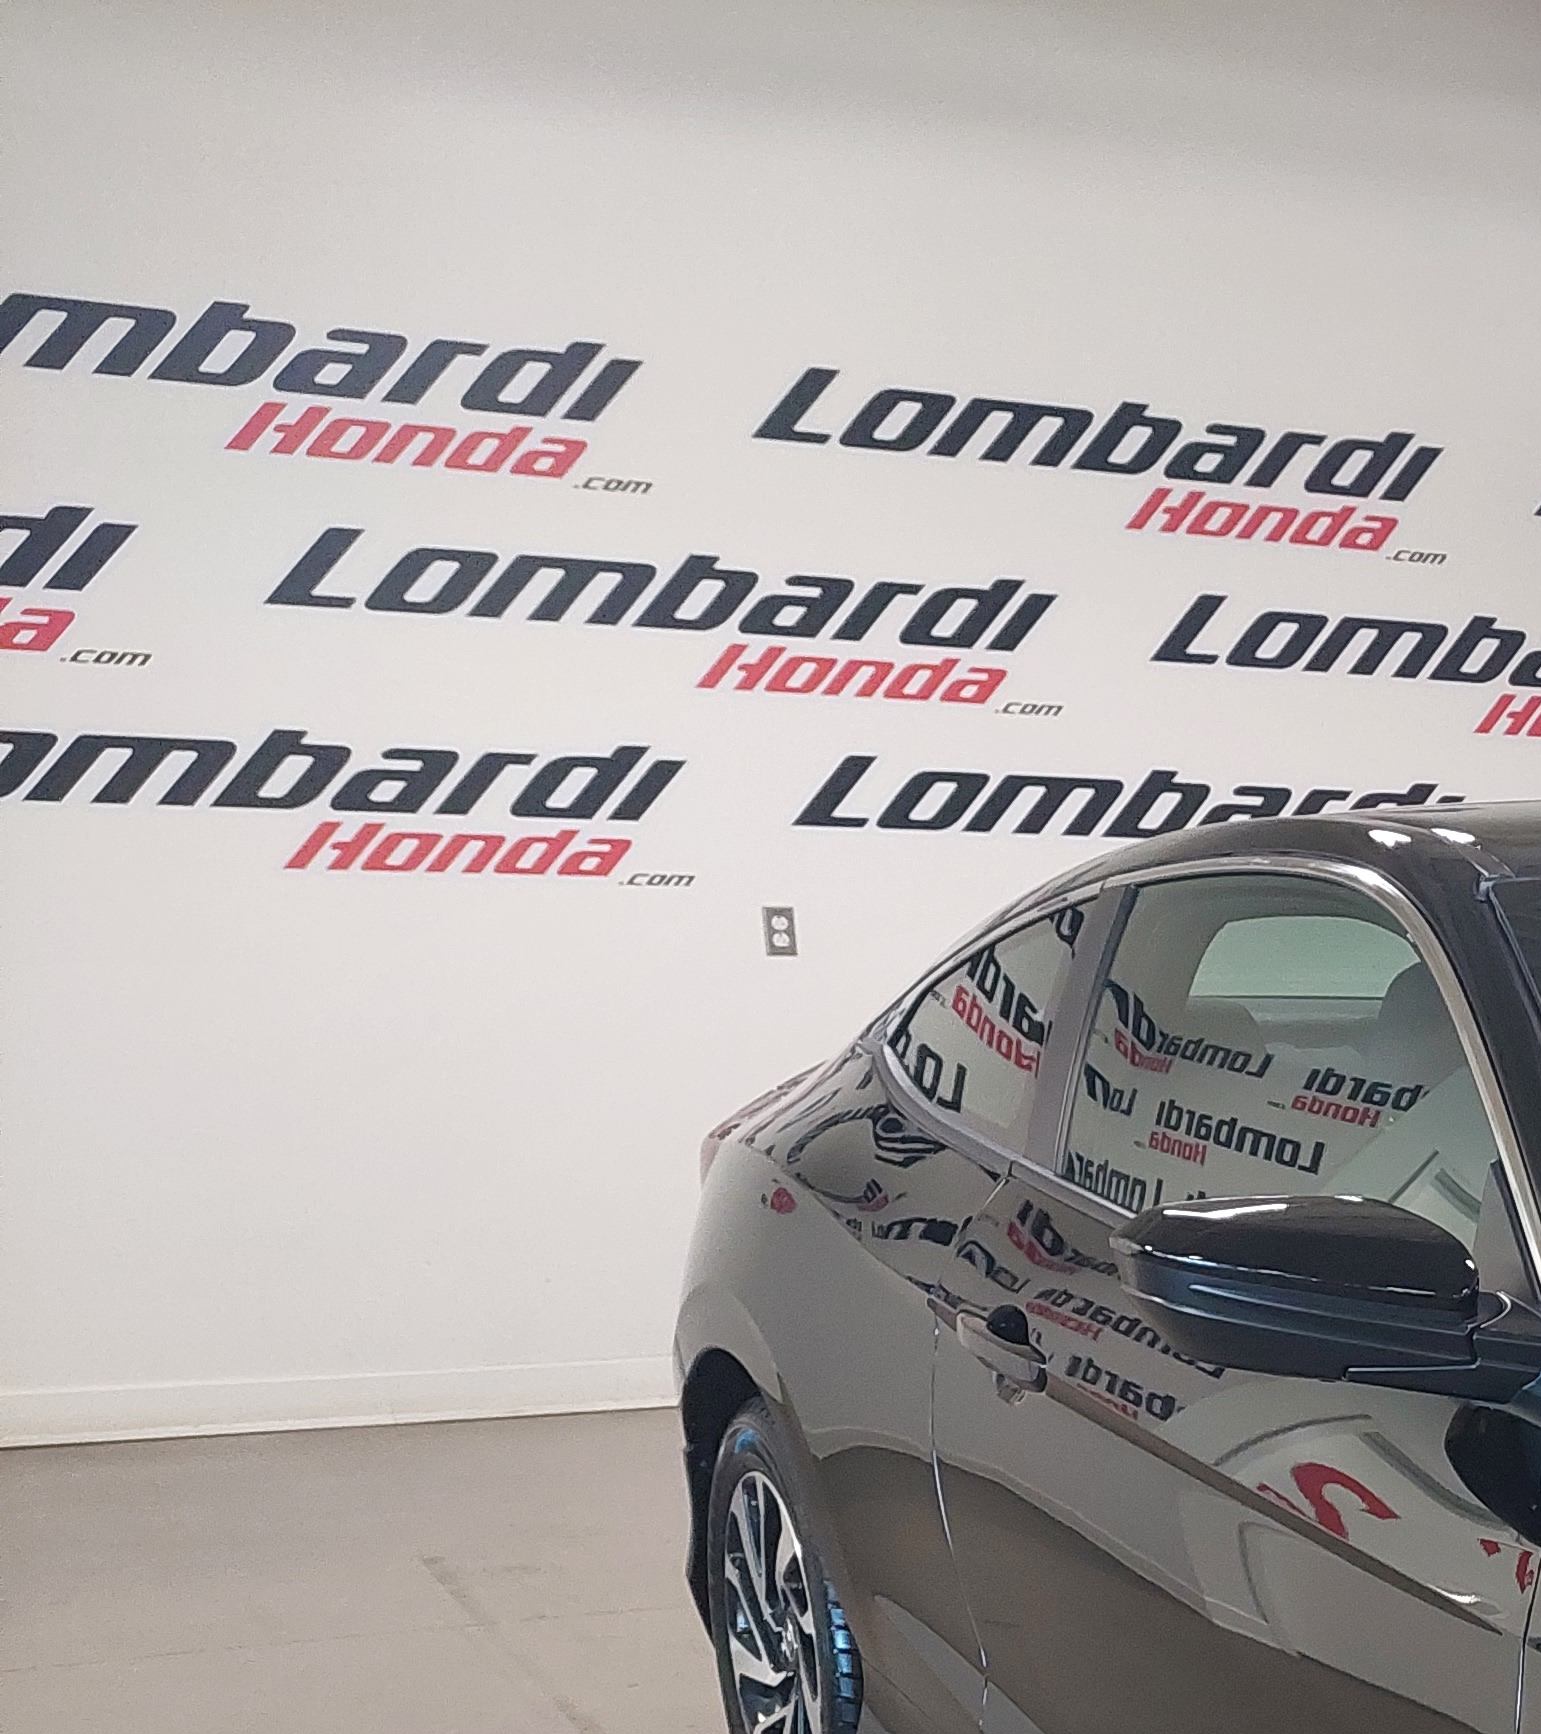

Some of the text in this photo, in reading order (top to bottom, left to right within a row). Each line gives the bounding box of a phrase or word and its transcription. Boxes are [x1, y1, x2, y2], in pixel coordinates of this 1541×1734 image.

[0, 294, 642, 421] mbardi
[227, 402, 586, 478] Honda
[754, 368, 1443, 501] Lombardi
[1127, 488, 1397, 551] Honda
[265, 528, 1057, 651] Lombardi
[698, 644, 1007, 704] Honda
[0, 730, 685, 820] mbardi
[286, 821, 632, 877] Honda
